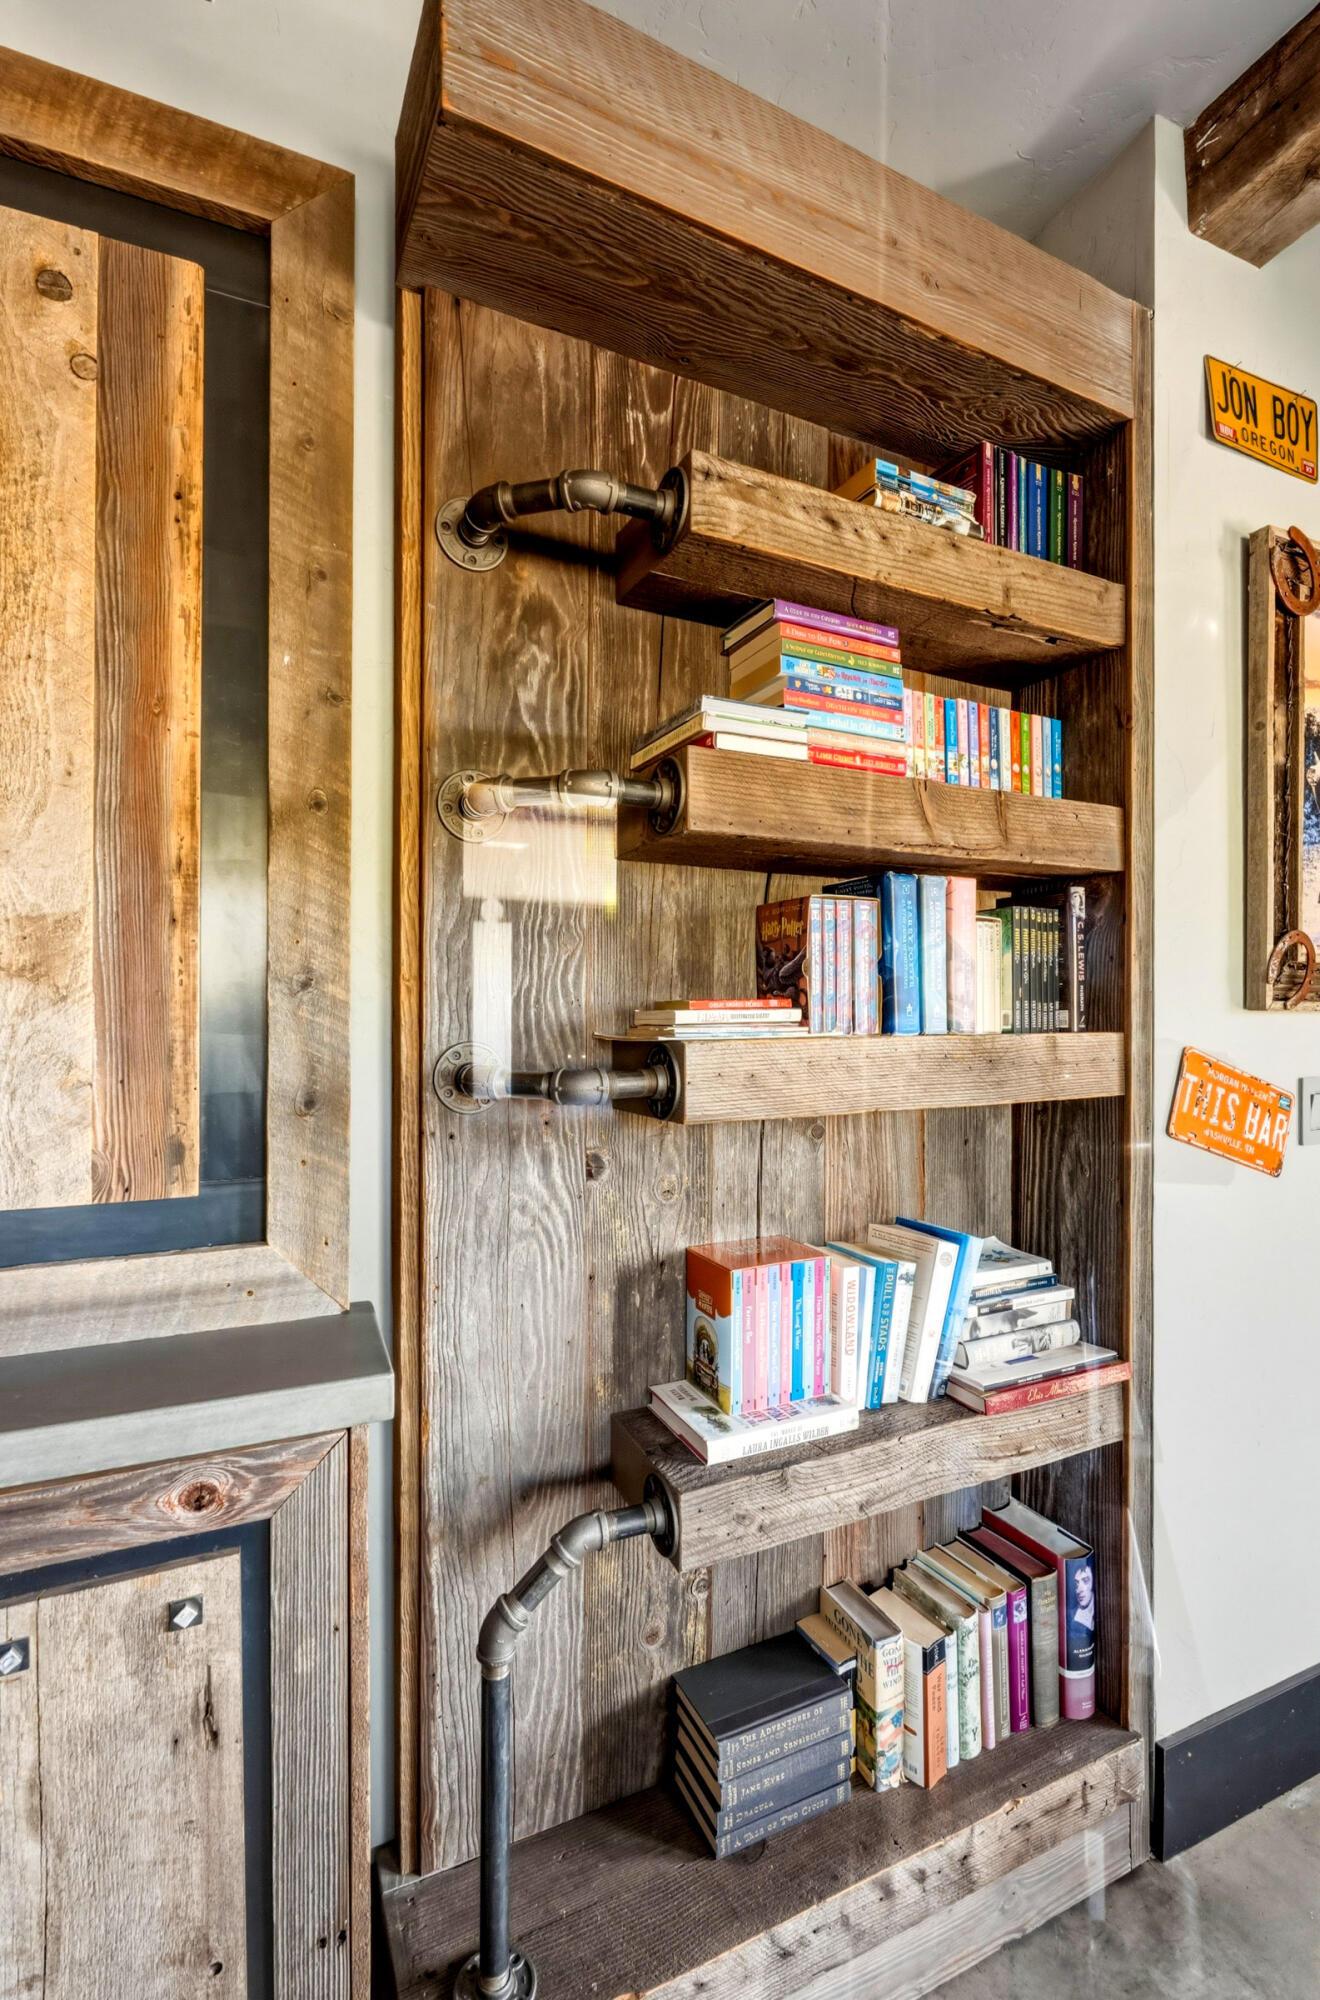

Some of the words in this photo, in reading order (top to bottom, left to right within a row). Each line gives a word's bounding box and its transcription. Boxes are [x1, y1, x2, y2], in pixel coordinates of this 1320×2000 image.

[1217, 371, 1258, 429] JON
[1272, 395, 1313, 452] BOY
[1241, 427, 1295, 465] OREGON
[761, 920, 781, 942] Harry
[781, 916, 804, 938] Potter
[1207, 1067, 1240, 1090] MORGAN
[1182, 1073, 1240, 1131] THIS
[1244, 1101, 1288, 1153] BAR
[883, 1275, 894, 1300] PULL
[845, 1280, 857, 1356] WIDOWLAND
[878, 1318, 889, 1351] STARS
[742, 1441, 768, 1456] LAURA
[769, 1432, 801, 1450] INGALLS
[802, 1426, 830, 1441] WILDER
[739, 1733, 757, 1746] THE
[759, 1711, 811, 1738] ADVENTURES
[813, 1706, 824, 1716] OF
[736, 1757, 761, 1772] SENSE
[764, 1747, 781, 1759] AND
[783, 1727, 831, 1751] SENSIBILITY
[740, 1784, 761, 1799] JANE
[763, 1773, 785, 1789] EYRE
[735, 1801, 774, 1824] DRACULA
[743, 1827, 765, 1843] TALE
[779, 1812, 799, 1827] TWO
